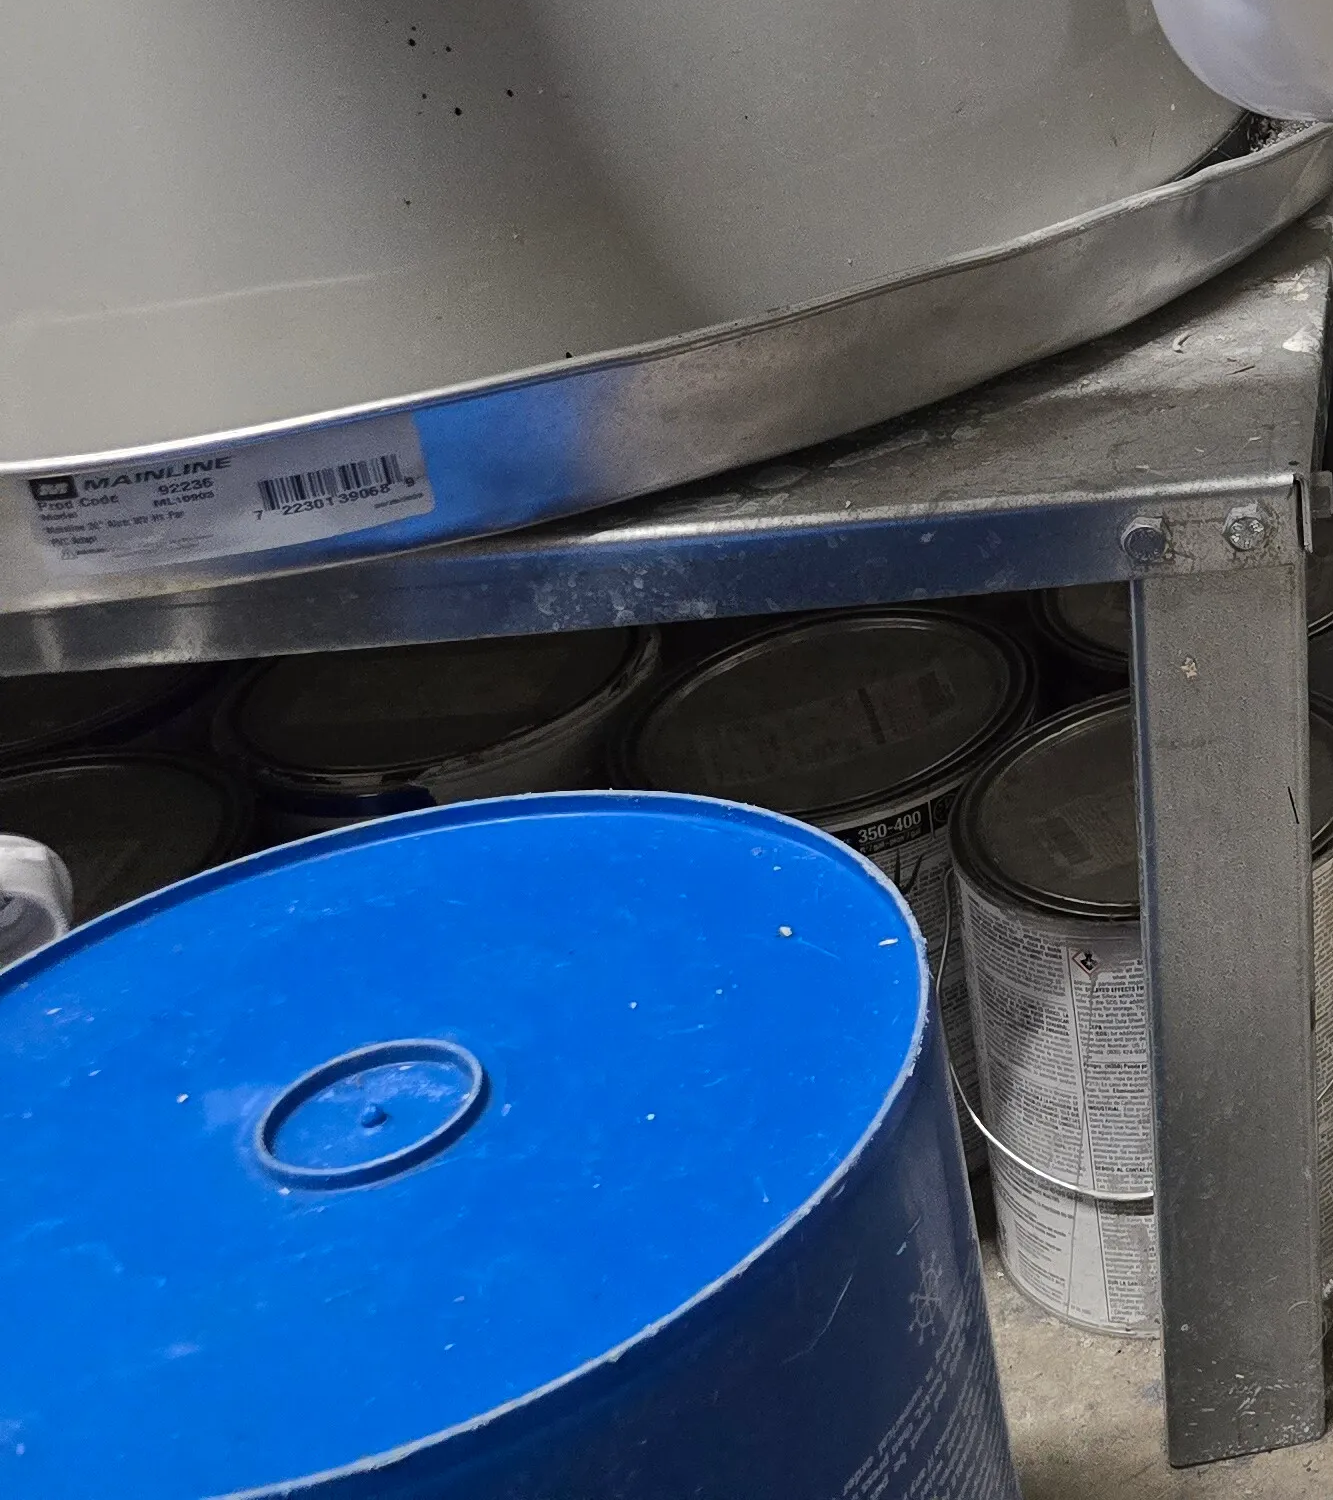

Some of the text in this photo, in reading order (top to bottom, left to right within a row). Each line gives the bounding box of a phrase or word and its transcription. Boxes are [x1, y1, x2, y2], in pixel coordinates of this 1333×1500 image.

[83, 456, 232, 491] MAINLINE
[37, 478, 214, 511] Prod Code 92236
[254, 510, 263, 520] 7
[338, 484, 391, 503] 39068
[405, 477, 414, 487] 9
[858, 811, 921, 842] 350-400
